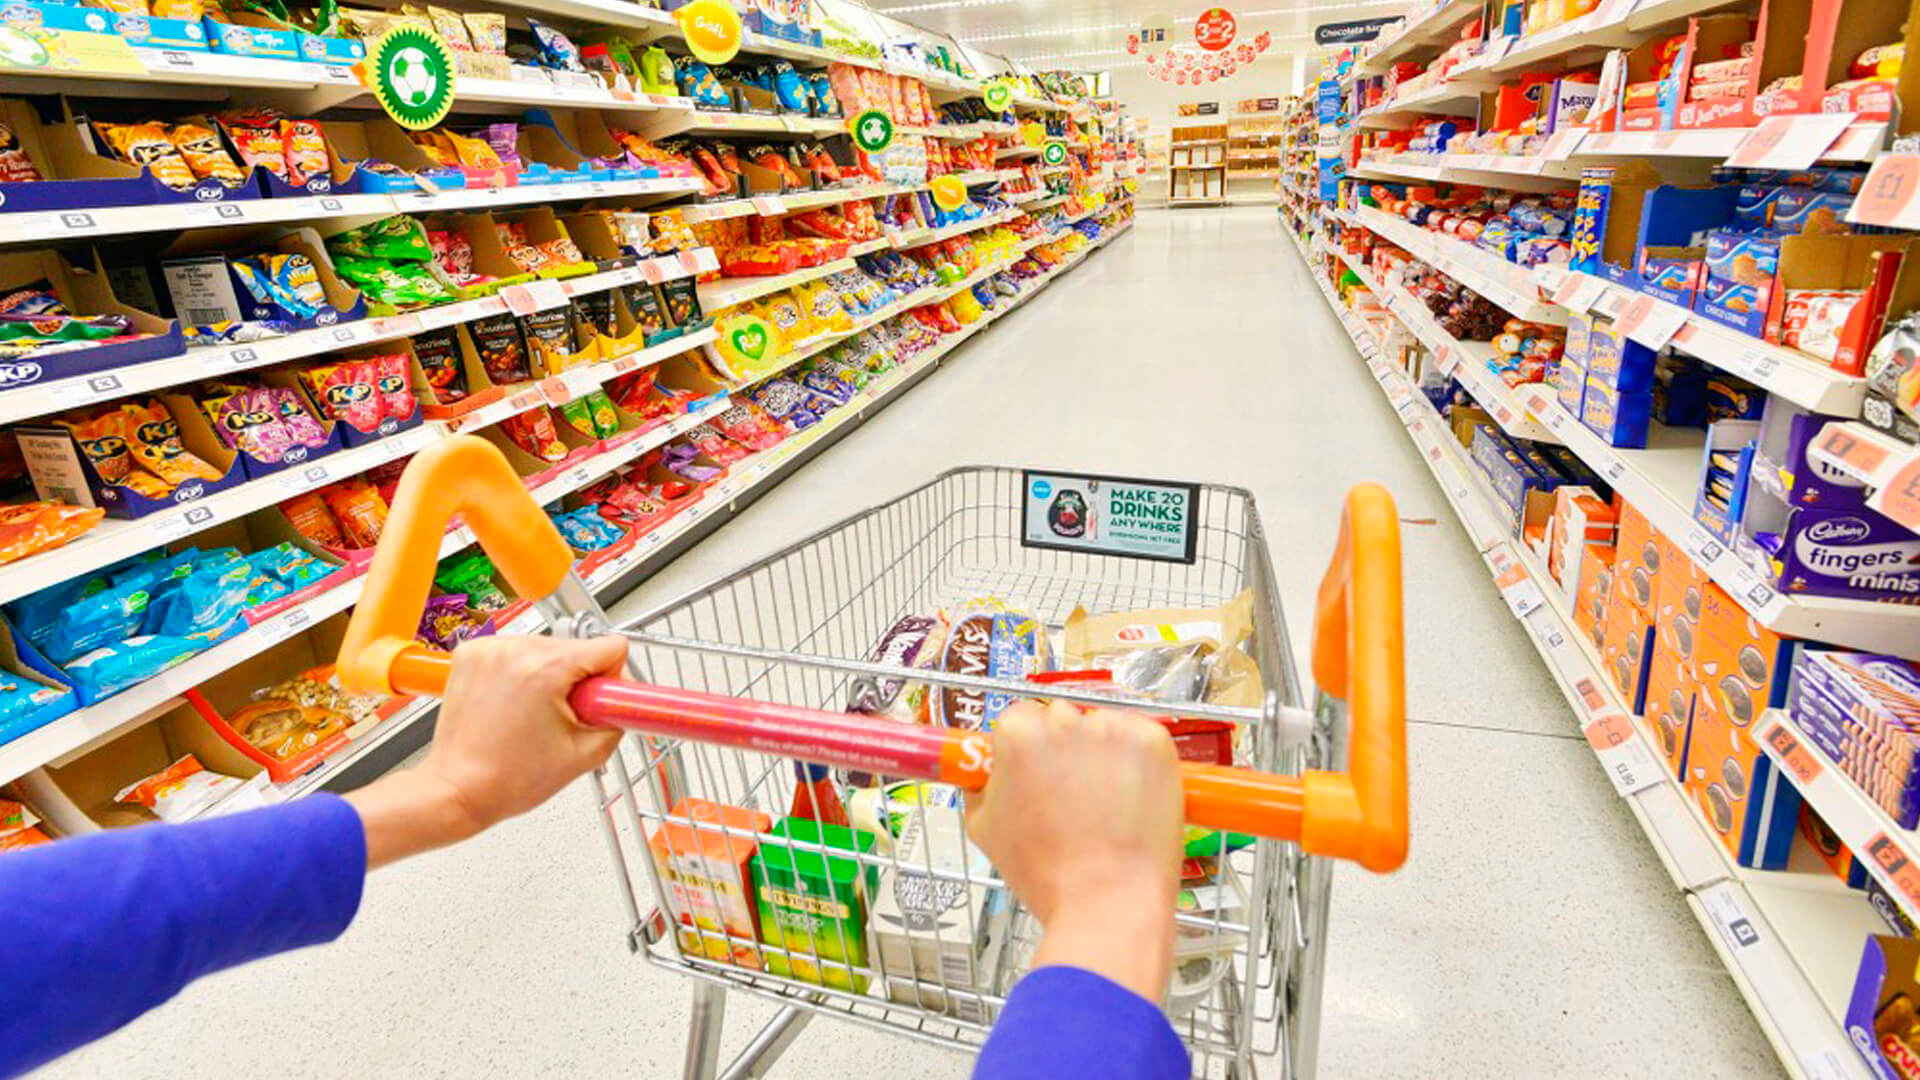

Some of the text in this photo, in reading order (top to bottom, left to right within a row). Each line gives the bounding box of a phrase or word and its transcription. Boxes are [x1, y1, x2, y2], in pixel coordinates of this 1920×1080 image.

[1197, 24, 1209, 40] 3
[1221, 21, 1234, 38] 2
[1320, 25, 1364, 38] Chocolate
[331, 384, 371, 403] KP
[230, 411, 271, 429] KP
[1110, 488, 1185, 506] MAKE 20
[1110, 501, 1183, 521] DRINKS
[1110, 518, 1182, 534] ANYWHERE
[1809, 521, 1865, 541] Cadbury
[1810, 547, 1903, 572] fingers
[1848, 571, 1920, 592] minis
